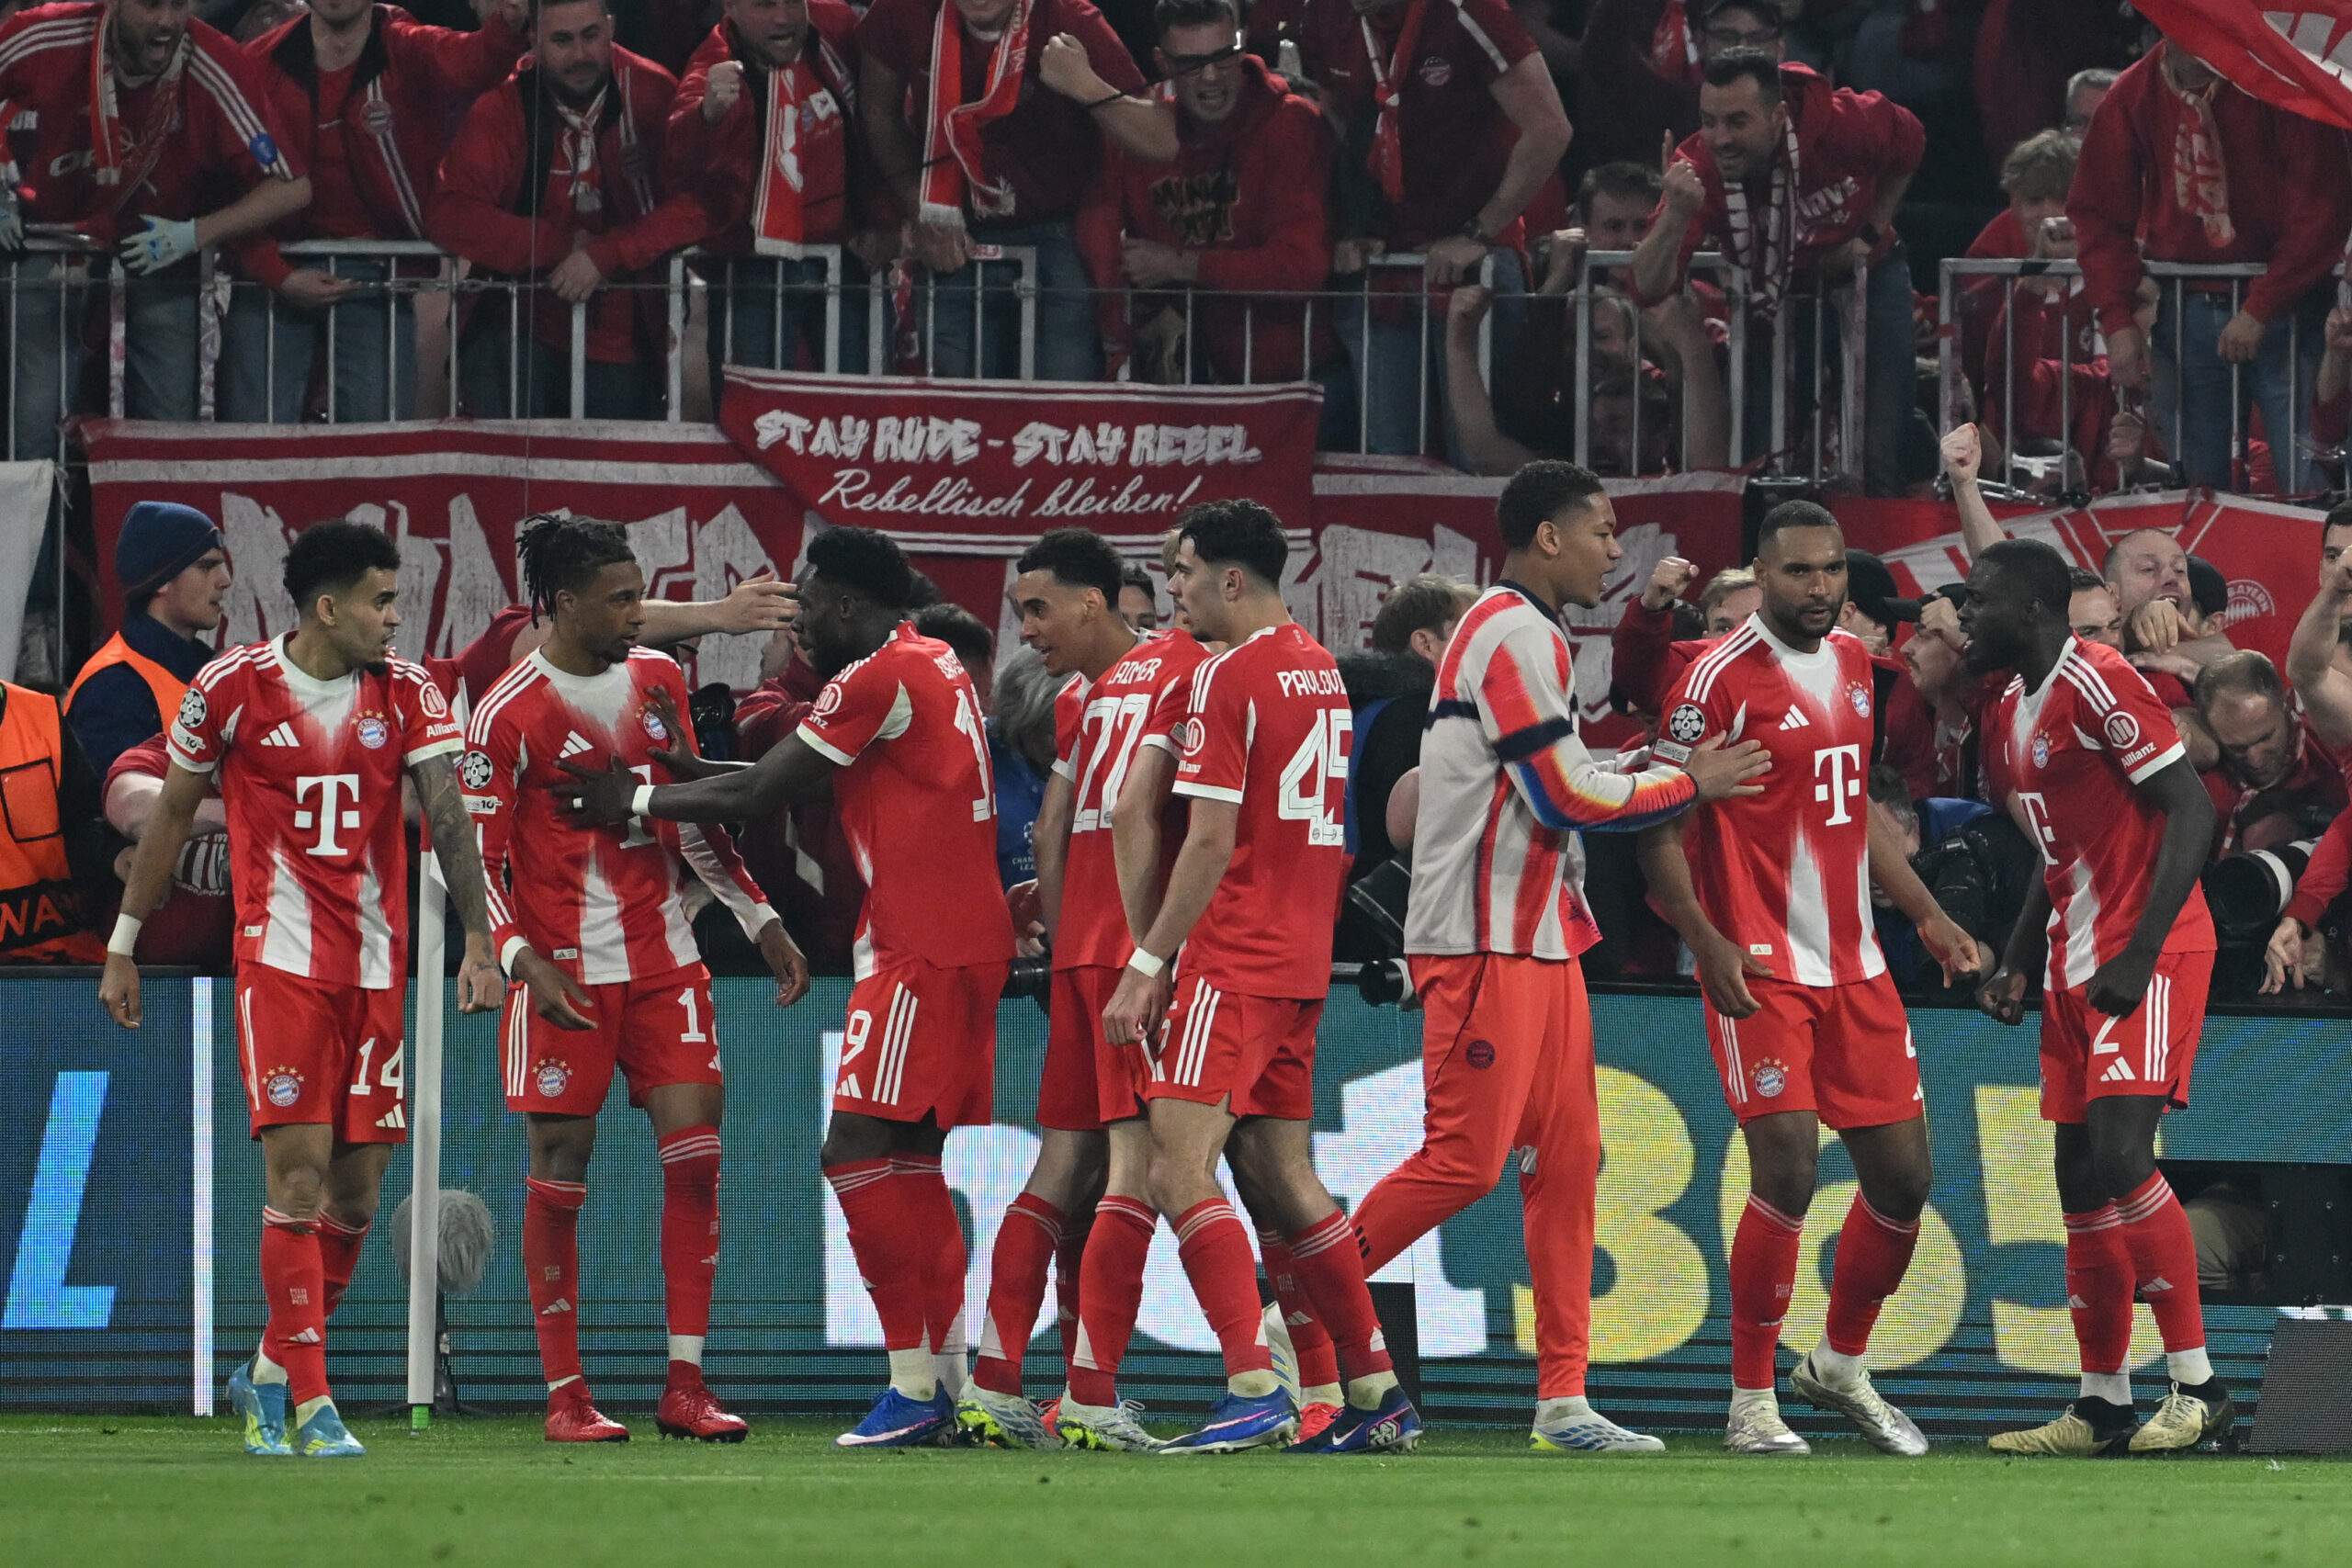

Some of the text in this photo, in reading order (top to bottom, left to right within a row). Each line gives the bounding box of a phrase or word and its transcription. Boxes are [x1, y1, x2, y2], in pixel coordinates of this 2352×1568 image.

[753, 409, 870, 460] STAY
[873, 415, 981, 465] RUDE
[1012, 421, 1127, 467] STAY
[1129, 423, 1261, 467] REBEL
[819, 468, 1203, 517] Rebellisch bleiben!
[1277, 669, 1347, 697] PAVLOVI
[426, 722, 458, 738] Allian
[2120, 741, 2157, 769] Allianz
[1072, 694, 1152, 833] 27
[1278, 708, 1353, 846] 45
[842, 1010, 872, 1066] 9
[350, 1037, 404, 1100] 14
